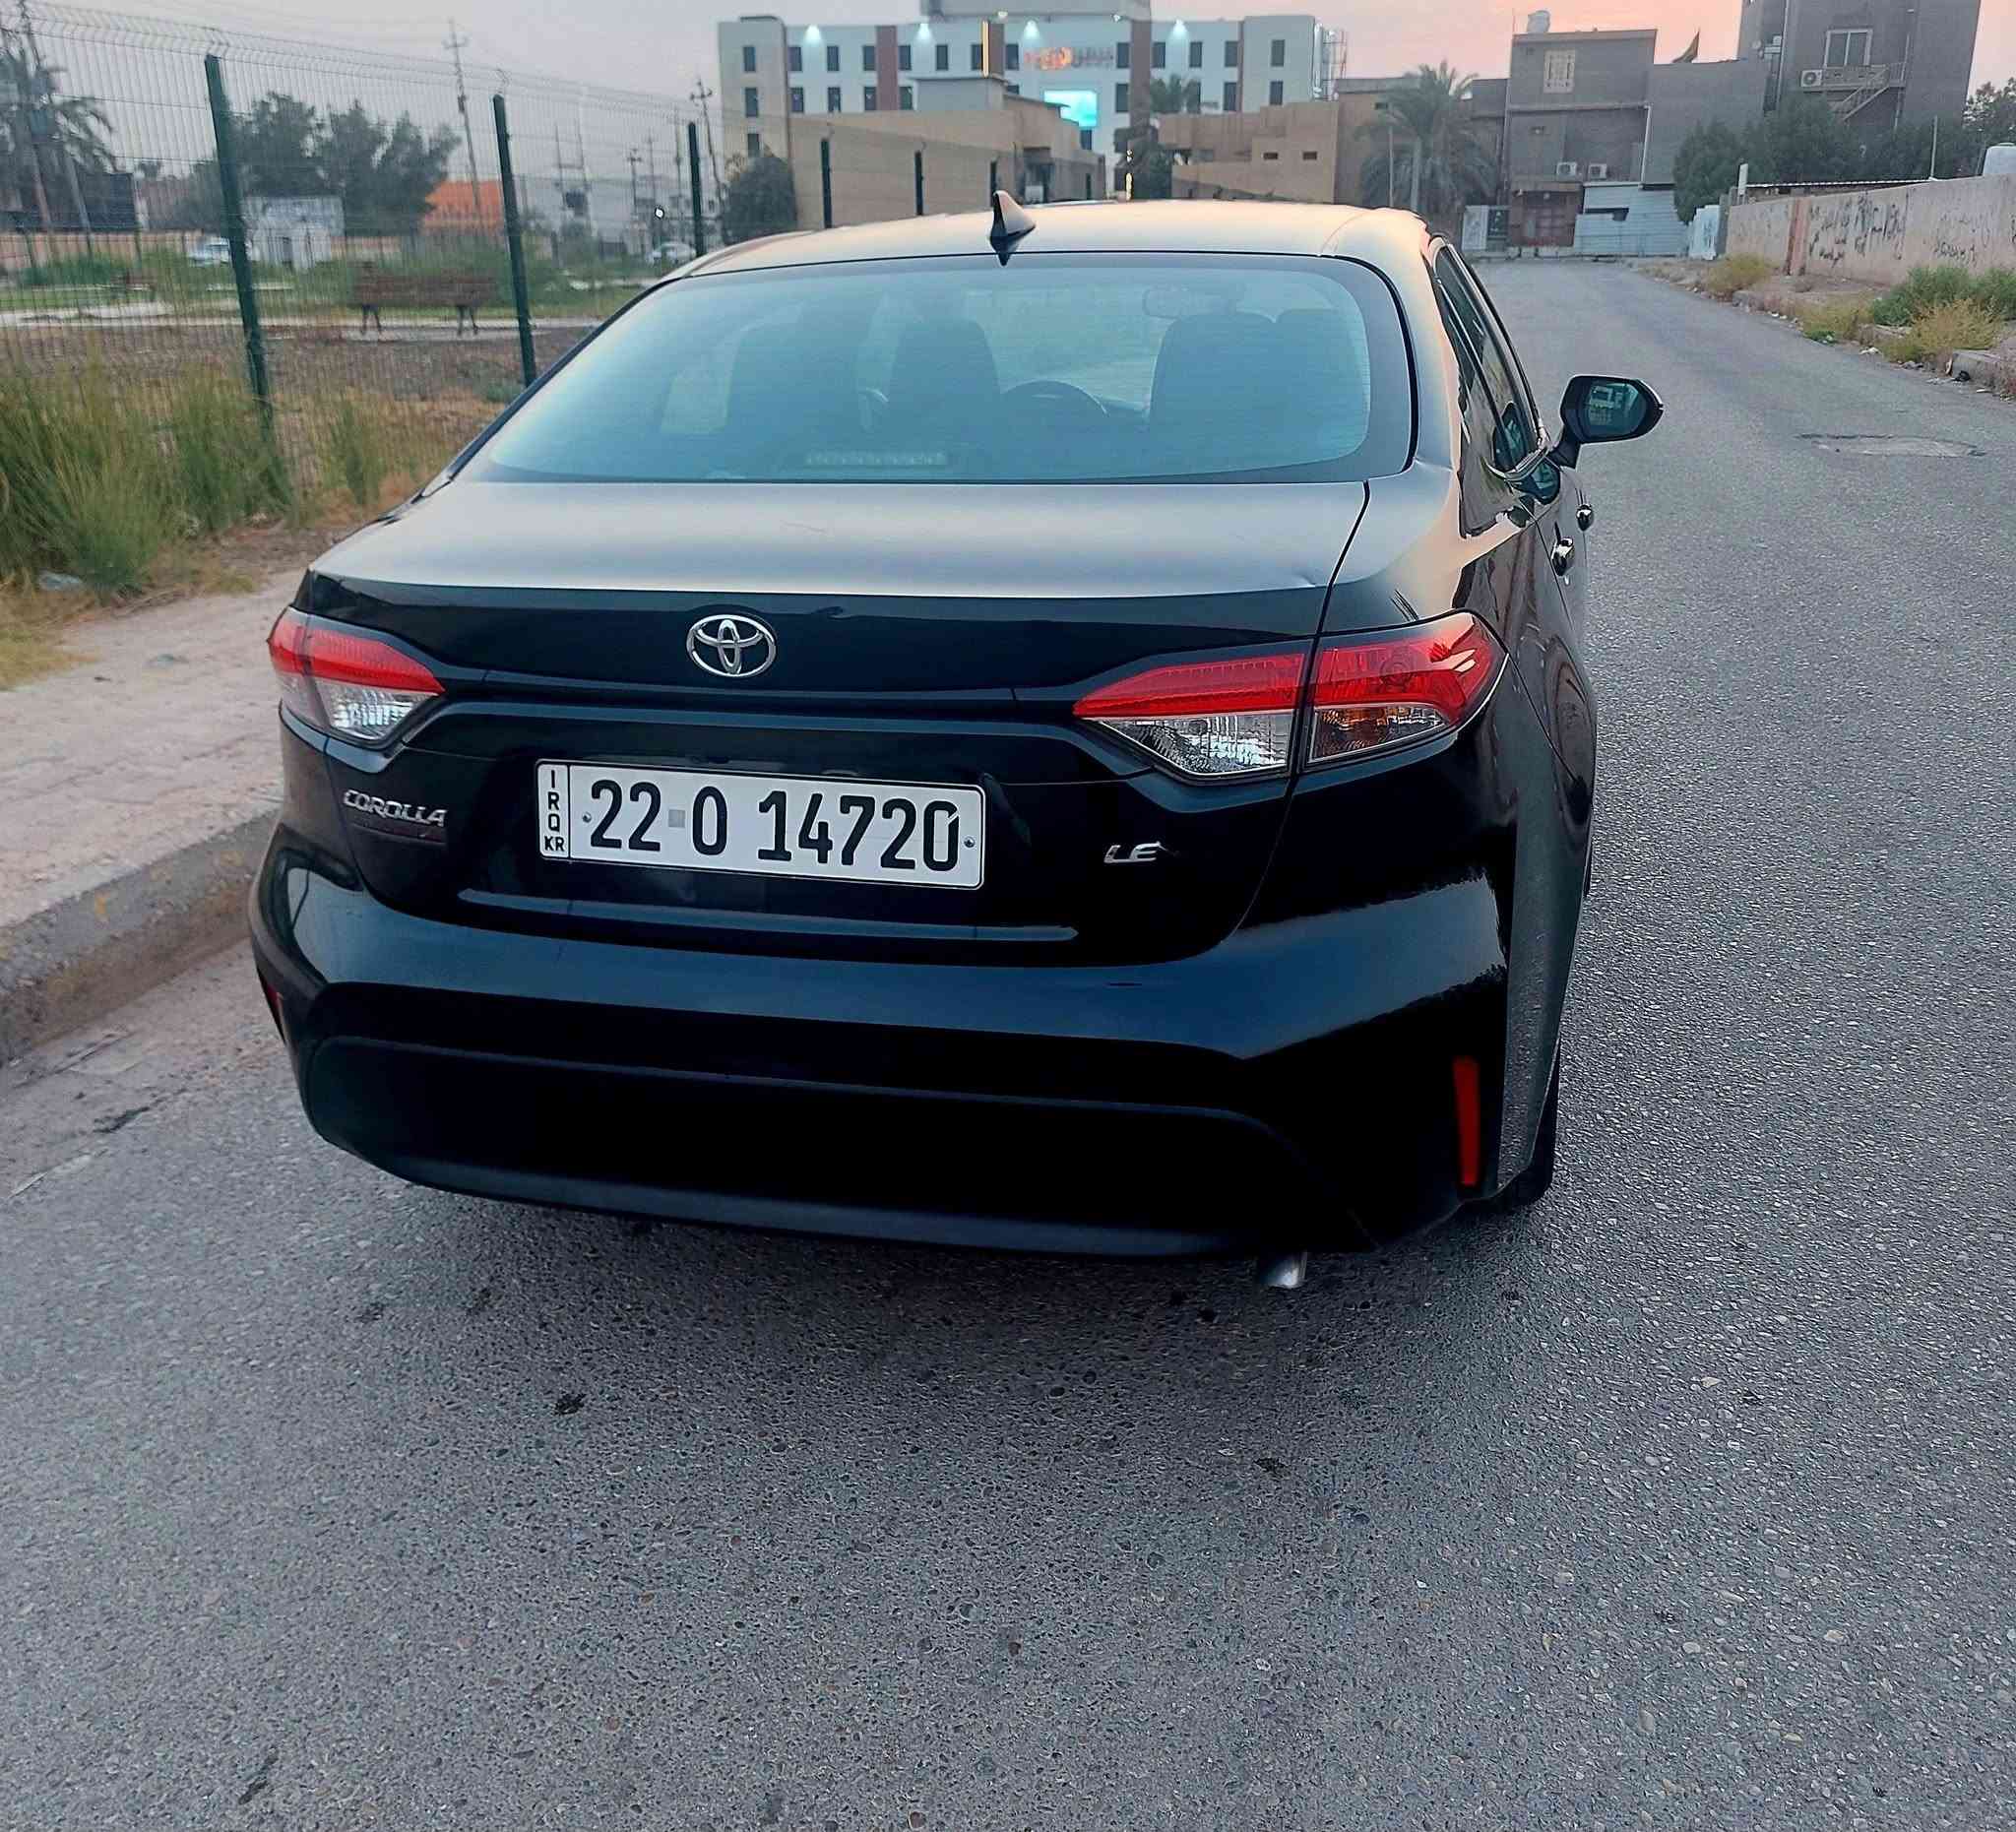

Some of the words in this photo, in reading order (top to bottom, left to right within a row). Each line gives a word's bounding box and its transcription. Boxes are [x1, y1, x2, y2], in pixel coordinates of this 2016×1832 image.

[344, 789, 449, 828] COROLLA
[547, 769, 561, 833] IRQ
[543, 835, 566, 853] KR
[590, 779, 662, 852] 22
[691, 786, 728, 855] 0
[757, 790, 961, 873] 14720
[1103, 842, 1161, 863] LE
